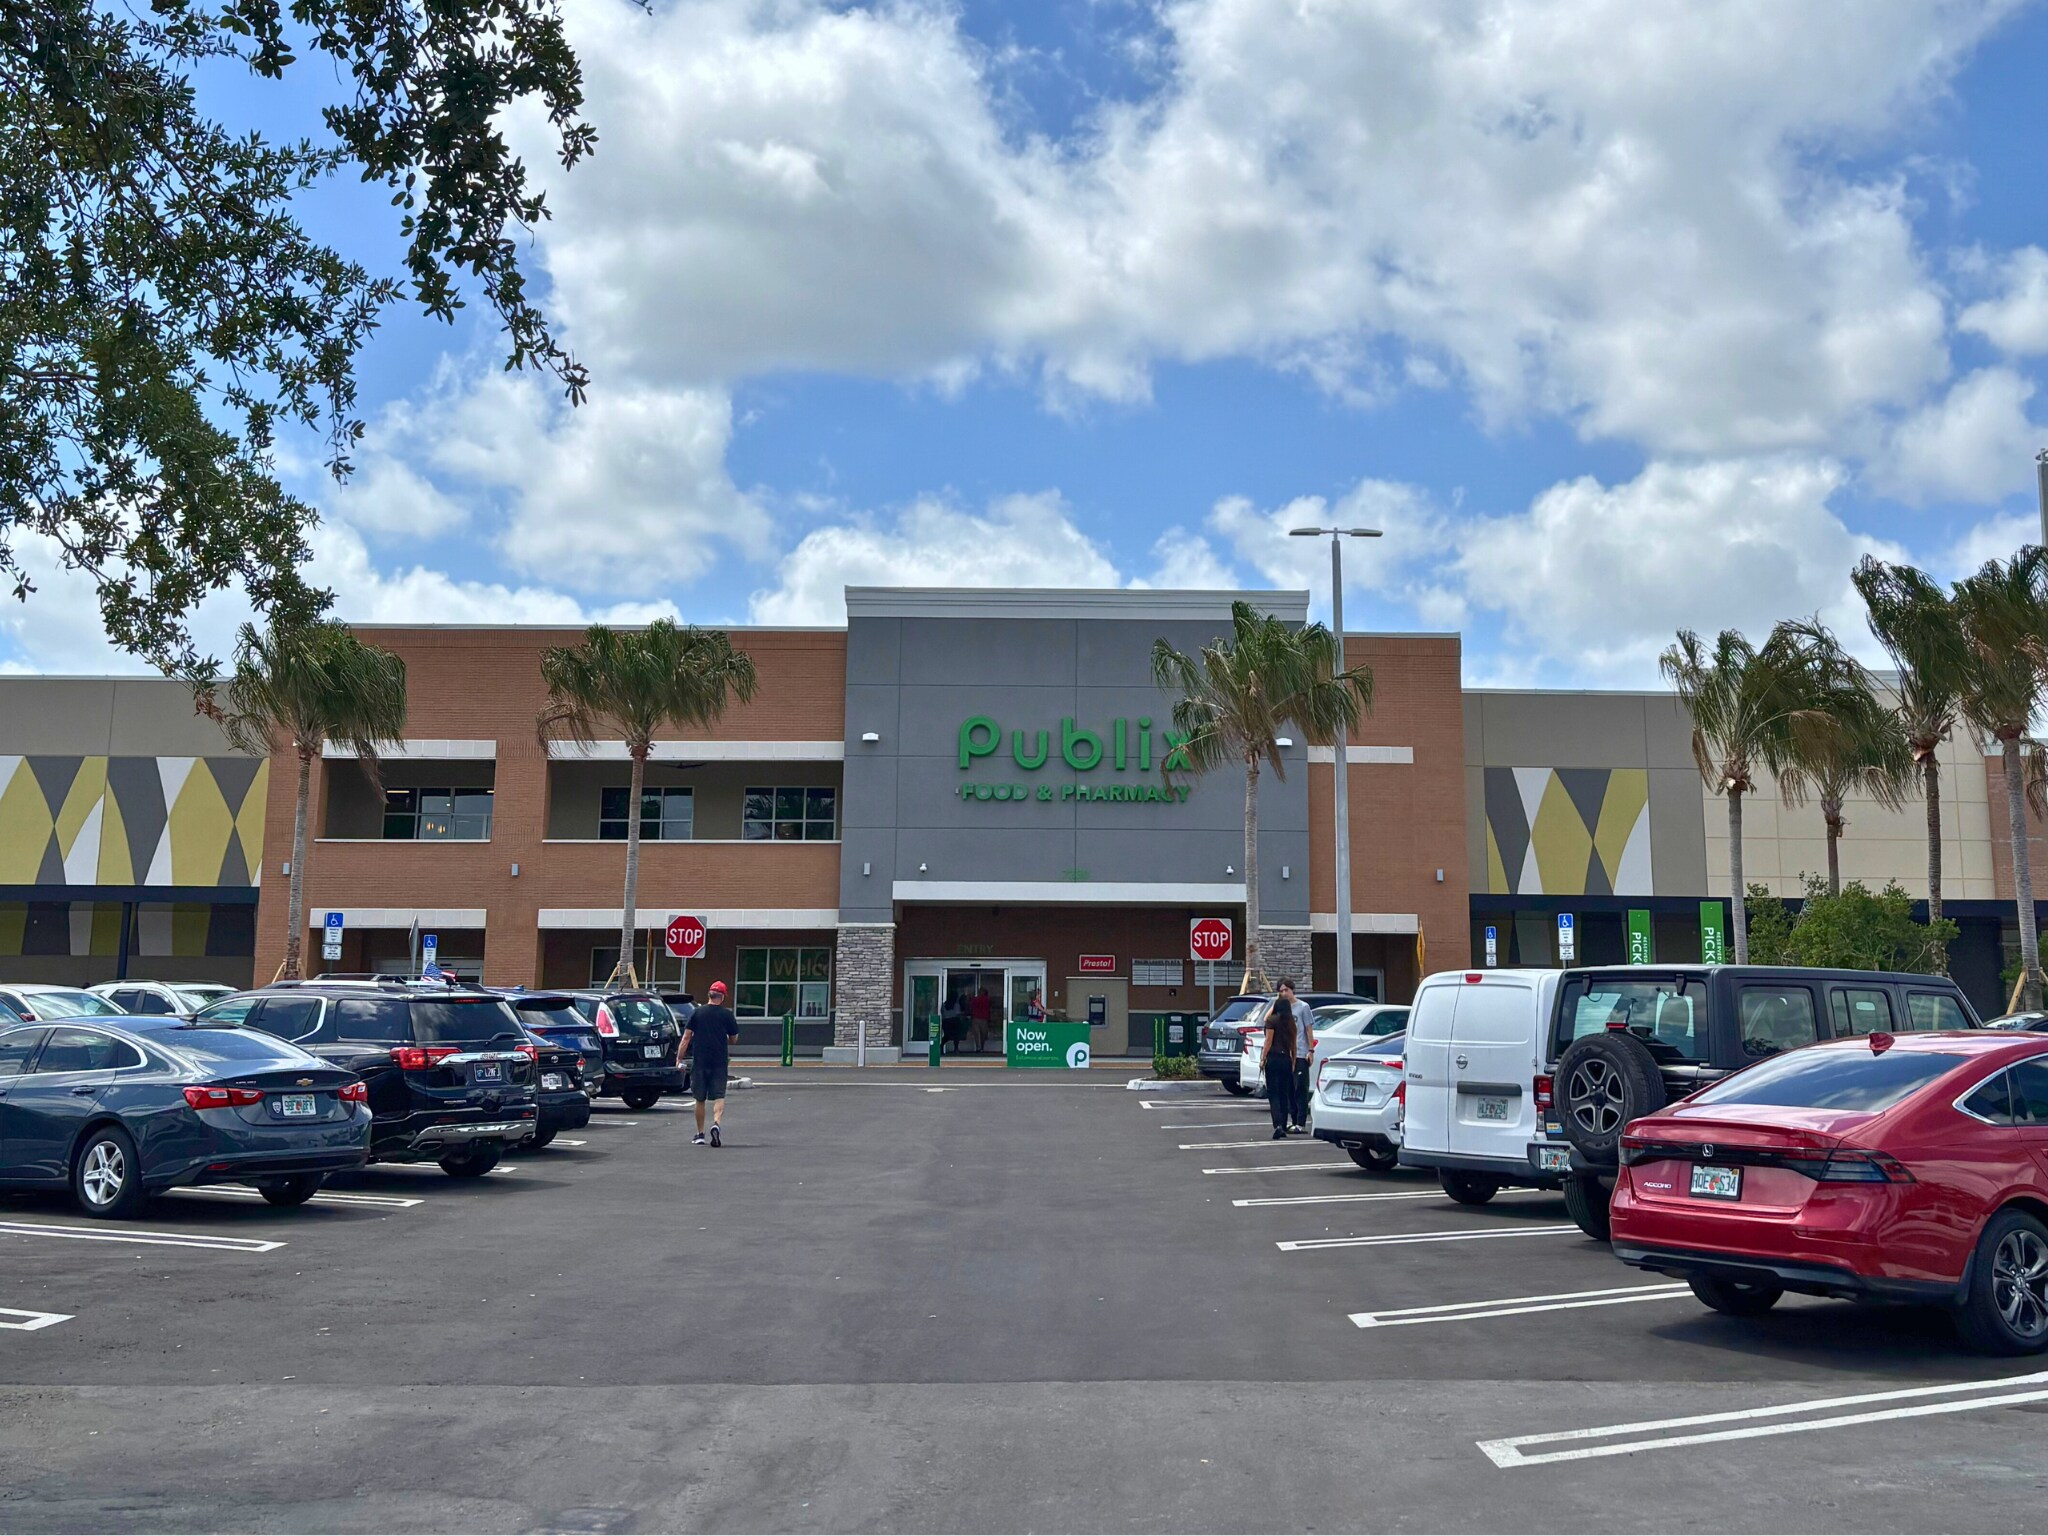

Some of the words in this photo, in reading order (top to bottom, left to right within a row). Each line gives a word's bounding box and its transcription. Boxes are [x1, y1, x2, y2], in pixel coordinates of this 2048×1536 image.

[959, 715, 1193, 771] Publix
[962, 784, 1029, 801] FOOD
[1036, 784, 1052, 801] &
[1061, 784, 1191, 802] PHARMACY
[669, 928, 703, 945] STOP
[1193, 931, 1229, 947] STOP
[1083, 959, 1111, 968] Presto!
[1016, 1028, 1047, 1041] Now
[1016, 1042, 1053, 1055] open.
